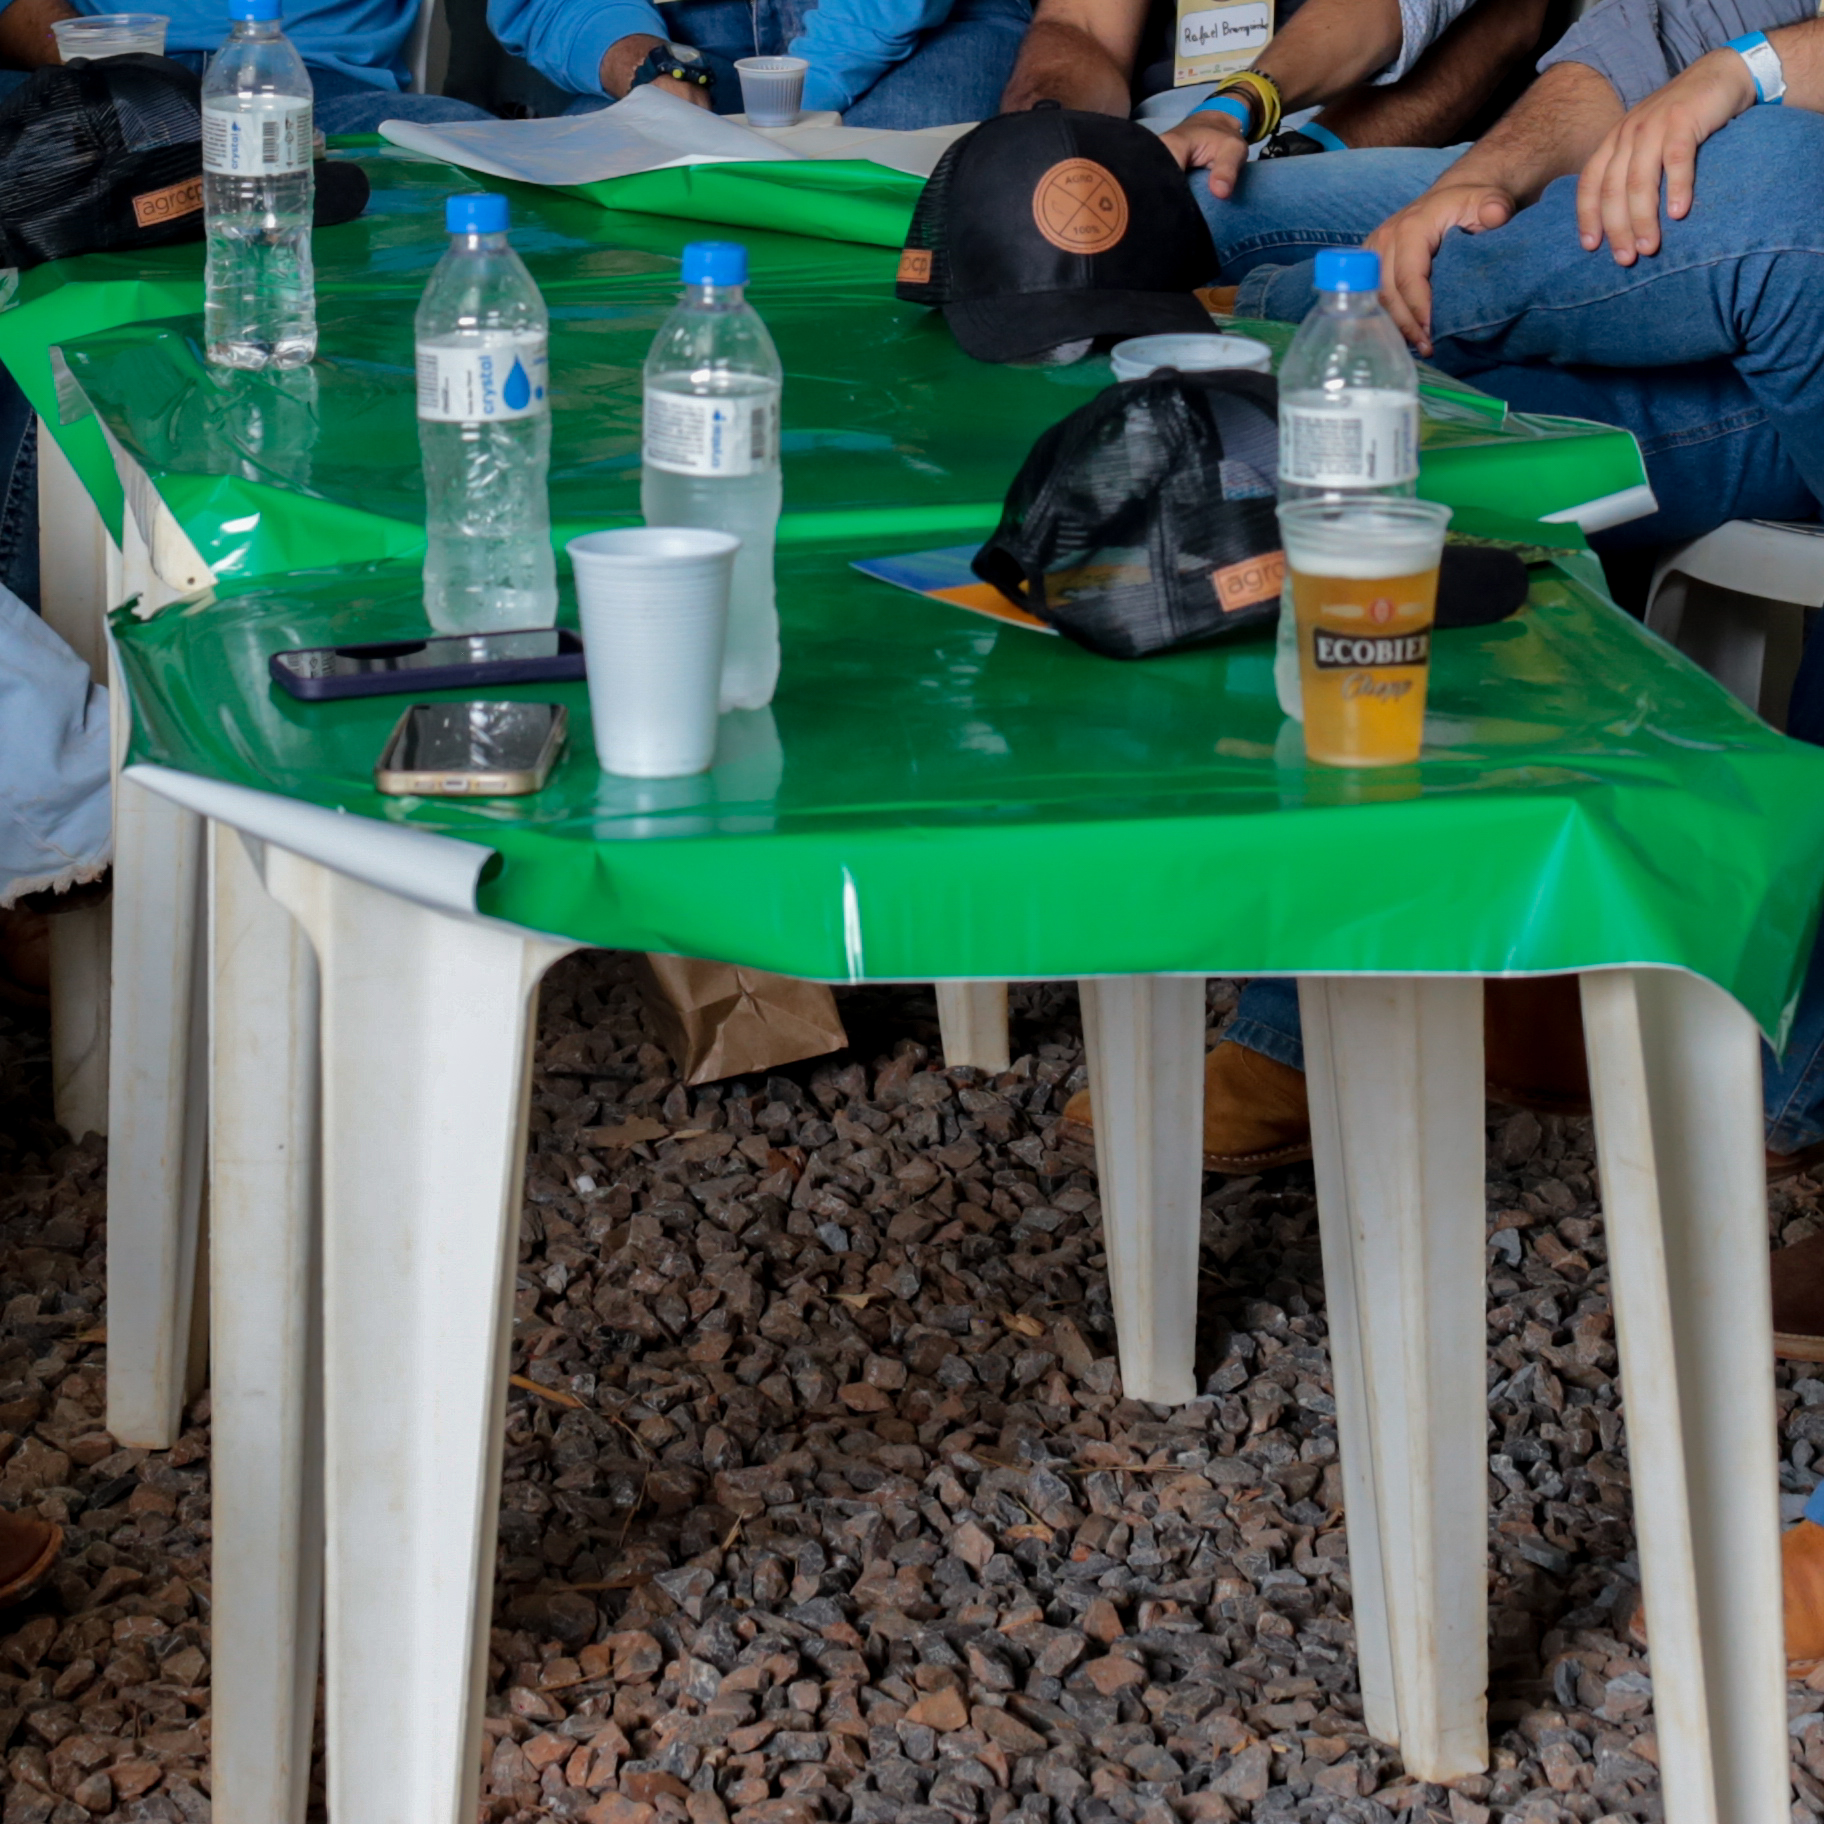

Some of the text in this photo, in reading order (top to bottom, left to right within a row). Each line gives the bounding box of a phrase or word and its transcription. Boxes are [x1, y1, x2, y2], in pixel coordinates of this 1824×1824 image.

[1184, 23, 1218, 46] Rafael
[231, 133, 240, 170] crystal
[1065, 174, 1094, 185] AGRO
[1073, 226, 1100, 235] 100%
[478, 356, 497, 414] crystal
[1228, 561, 1283, 594] agro
